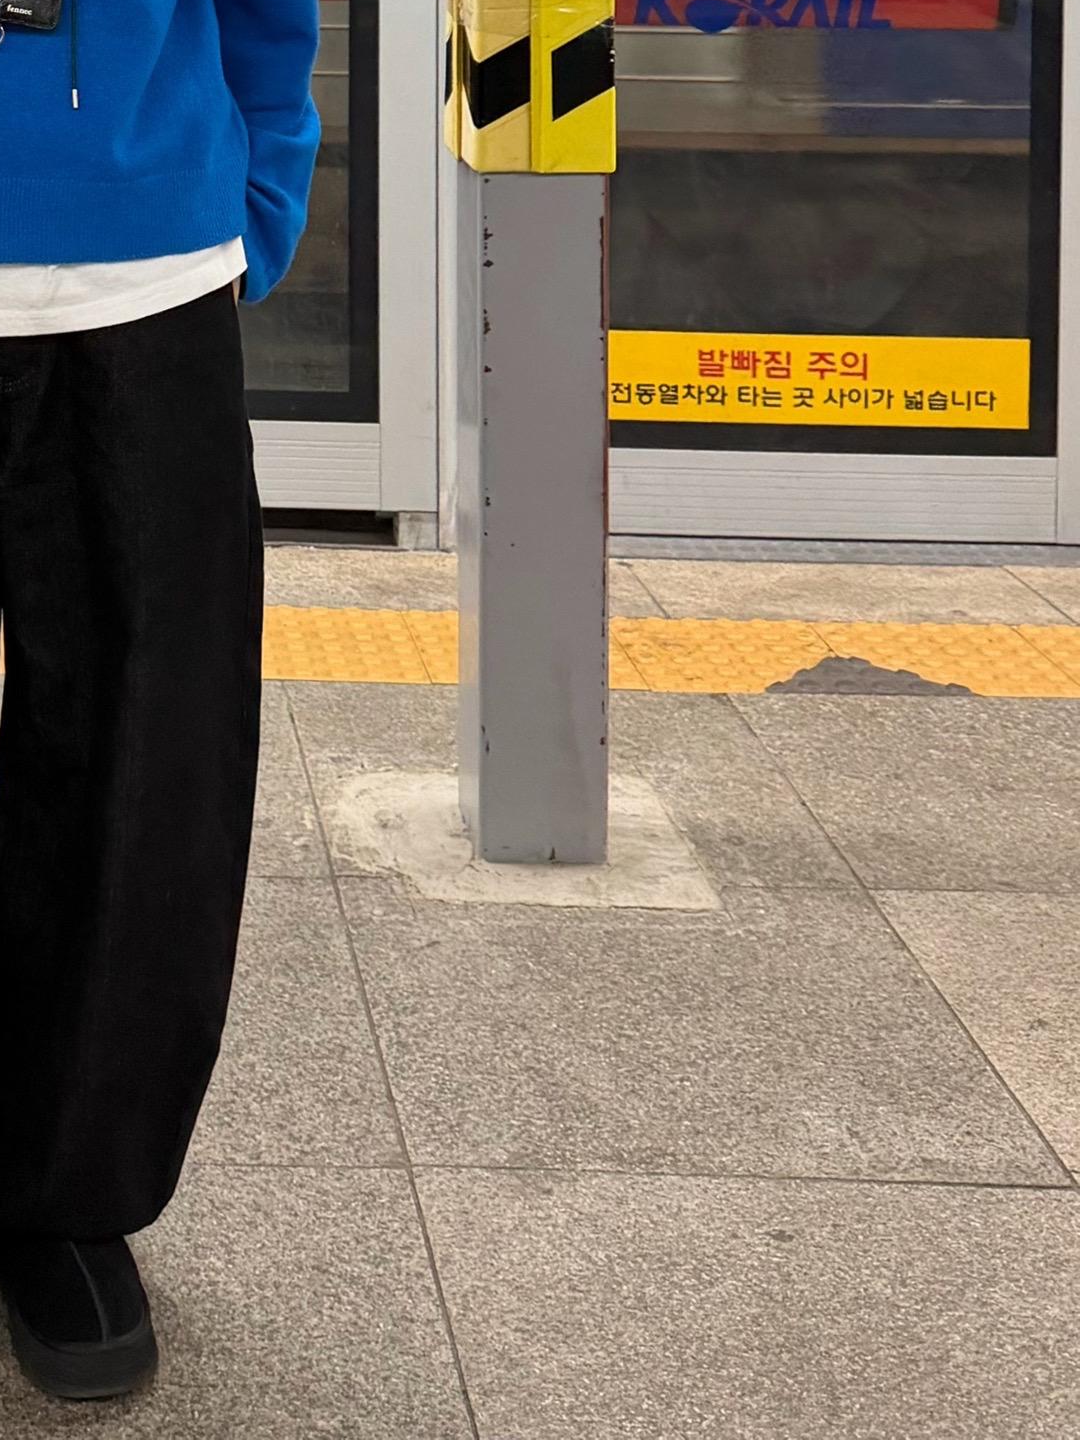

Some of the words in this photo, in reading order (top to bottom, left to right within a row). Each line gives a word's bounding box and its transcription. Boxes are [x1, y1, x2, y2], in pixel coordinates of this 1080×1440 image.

[698, 350, 792, 379] 발빠짐
[807, 351, 868, 381] 주의
[611, 382, 728, 406] 전동열차와
[737, 385, 783, 407] 타는
[793, 387, 814, 408] 곳
[823, 388, 894, 409] 사이가
[904, 390, 997, 411] 넓습니다
